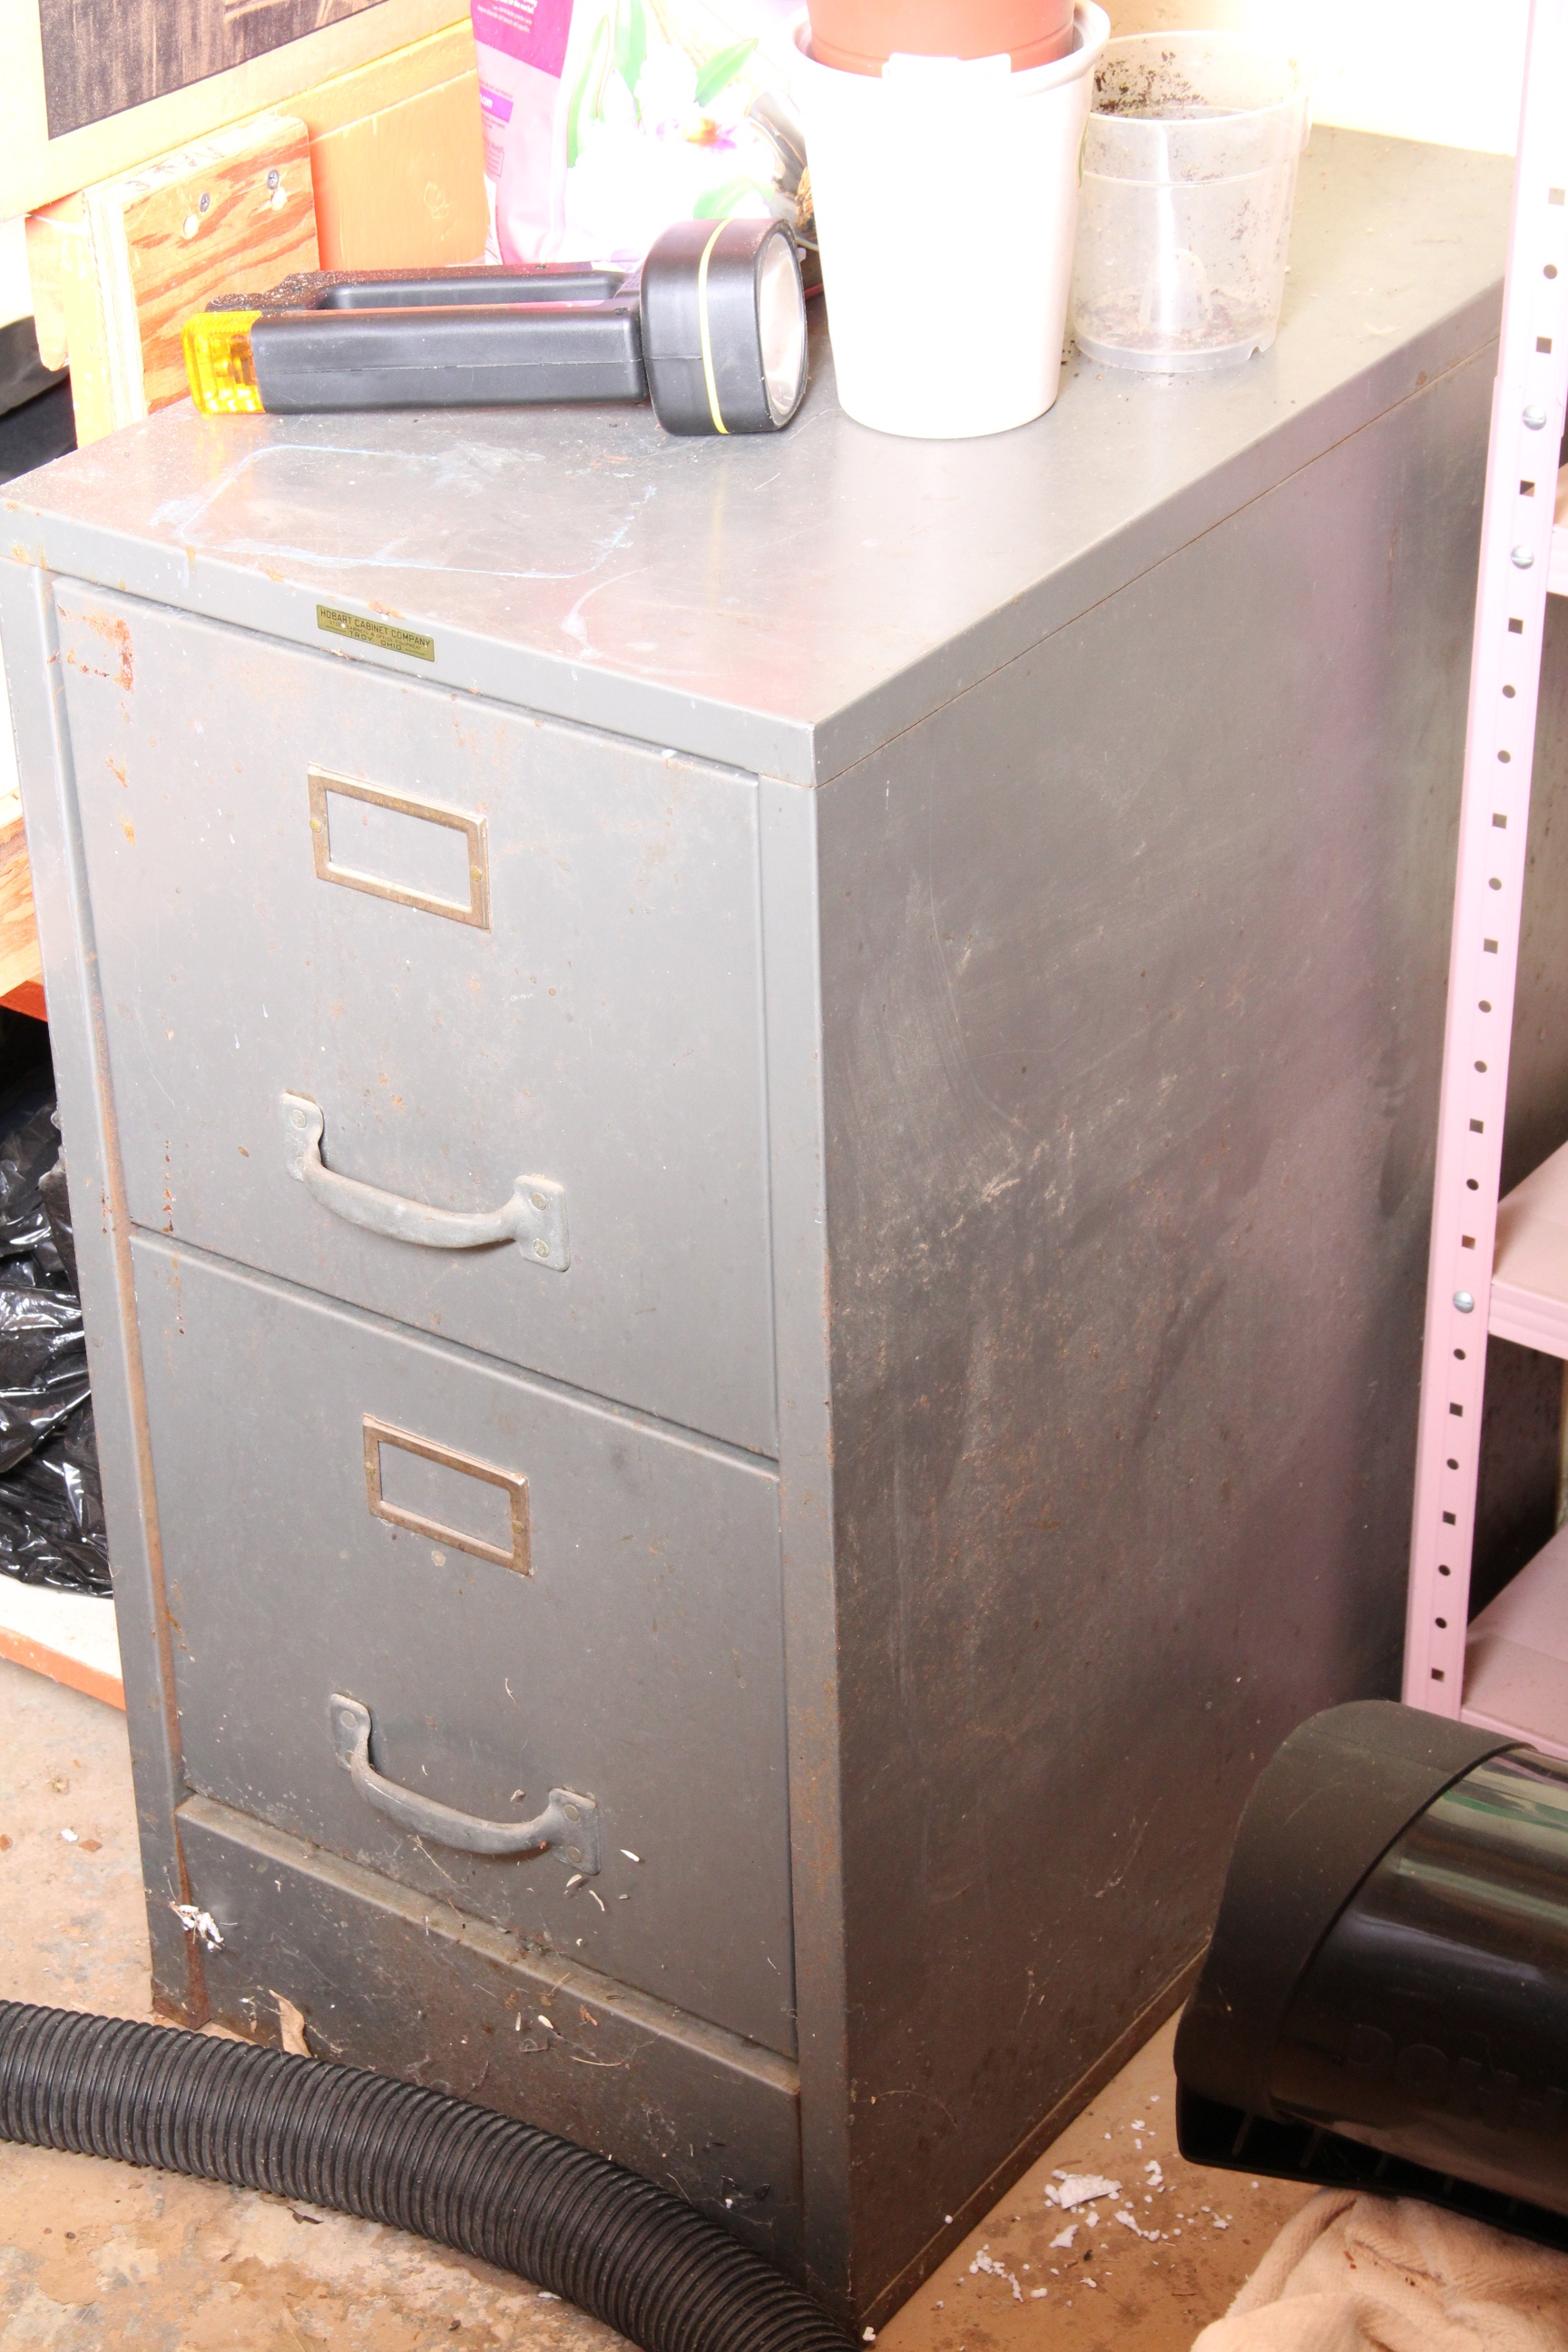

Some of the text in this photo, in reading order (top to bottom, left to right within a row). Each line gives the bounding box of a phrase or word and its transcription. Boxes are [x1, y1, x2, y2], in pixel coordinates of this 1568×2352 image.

[320, 609, 430, 647] HOBART CABINET COMPANY
[381, 640, 401, 651] OHIO
